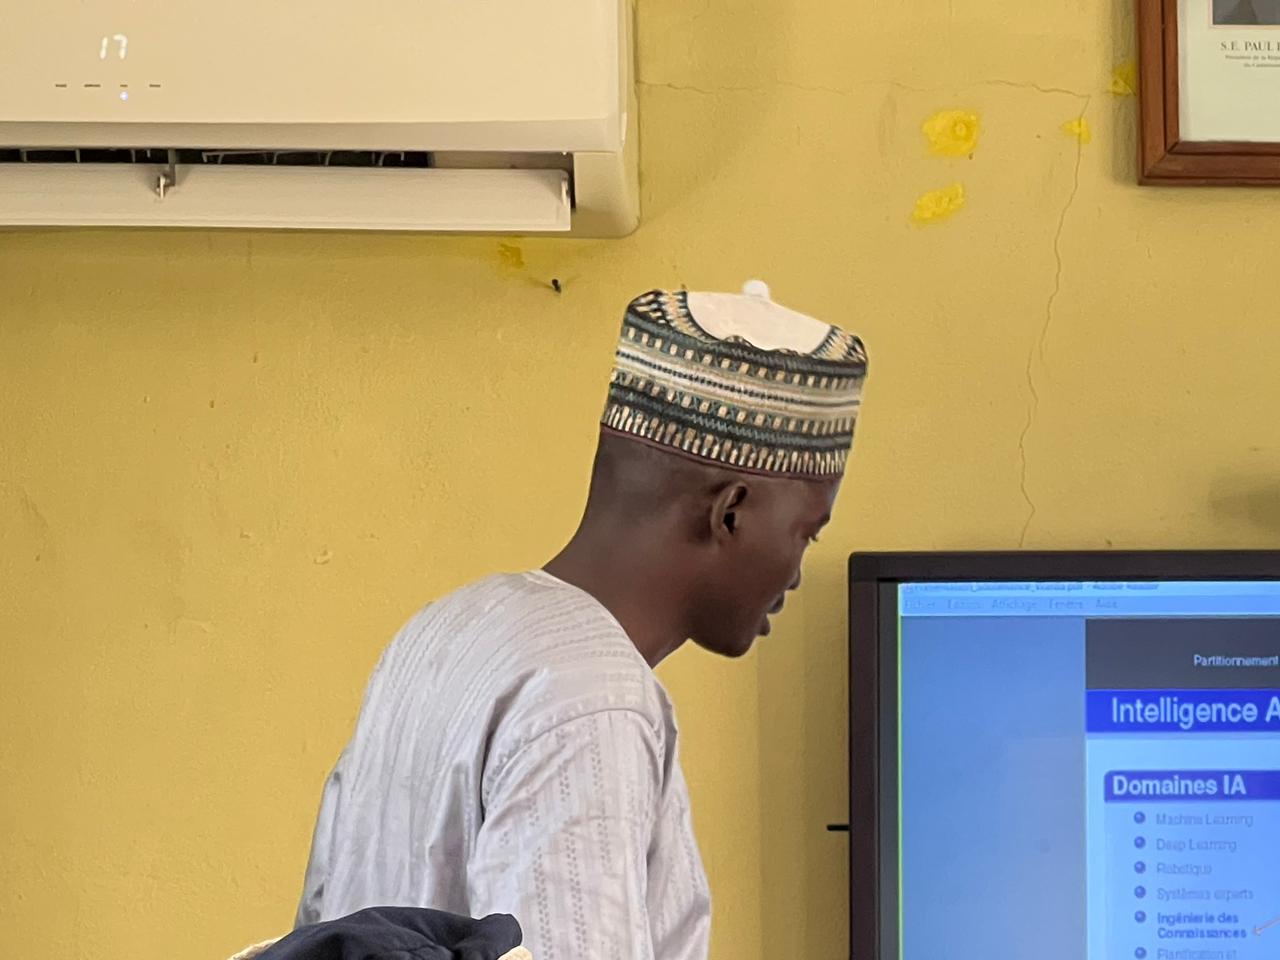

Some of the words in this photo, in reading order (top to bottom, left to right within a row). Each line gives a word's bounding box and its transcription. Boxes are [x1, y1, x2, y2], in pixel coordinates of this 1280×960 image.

[100, 34, 128, 59] 17
[1244, 41, 1273, 51] PAUL
[1194, 654, 1279, 666] Partitionnement
[1112, 697, 1258, 729] Intelligence
[1113, 775, 1218, 796] Domaines
[1223, 774, 1247, 795] IA
[1157, 912, 1215, 926] Ingénierie
[1218, 913, 1239, 923] des
[1157, 928, 1247, 939] Connaissances
